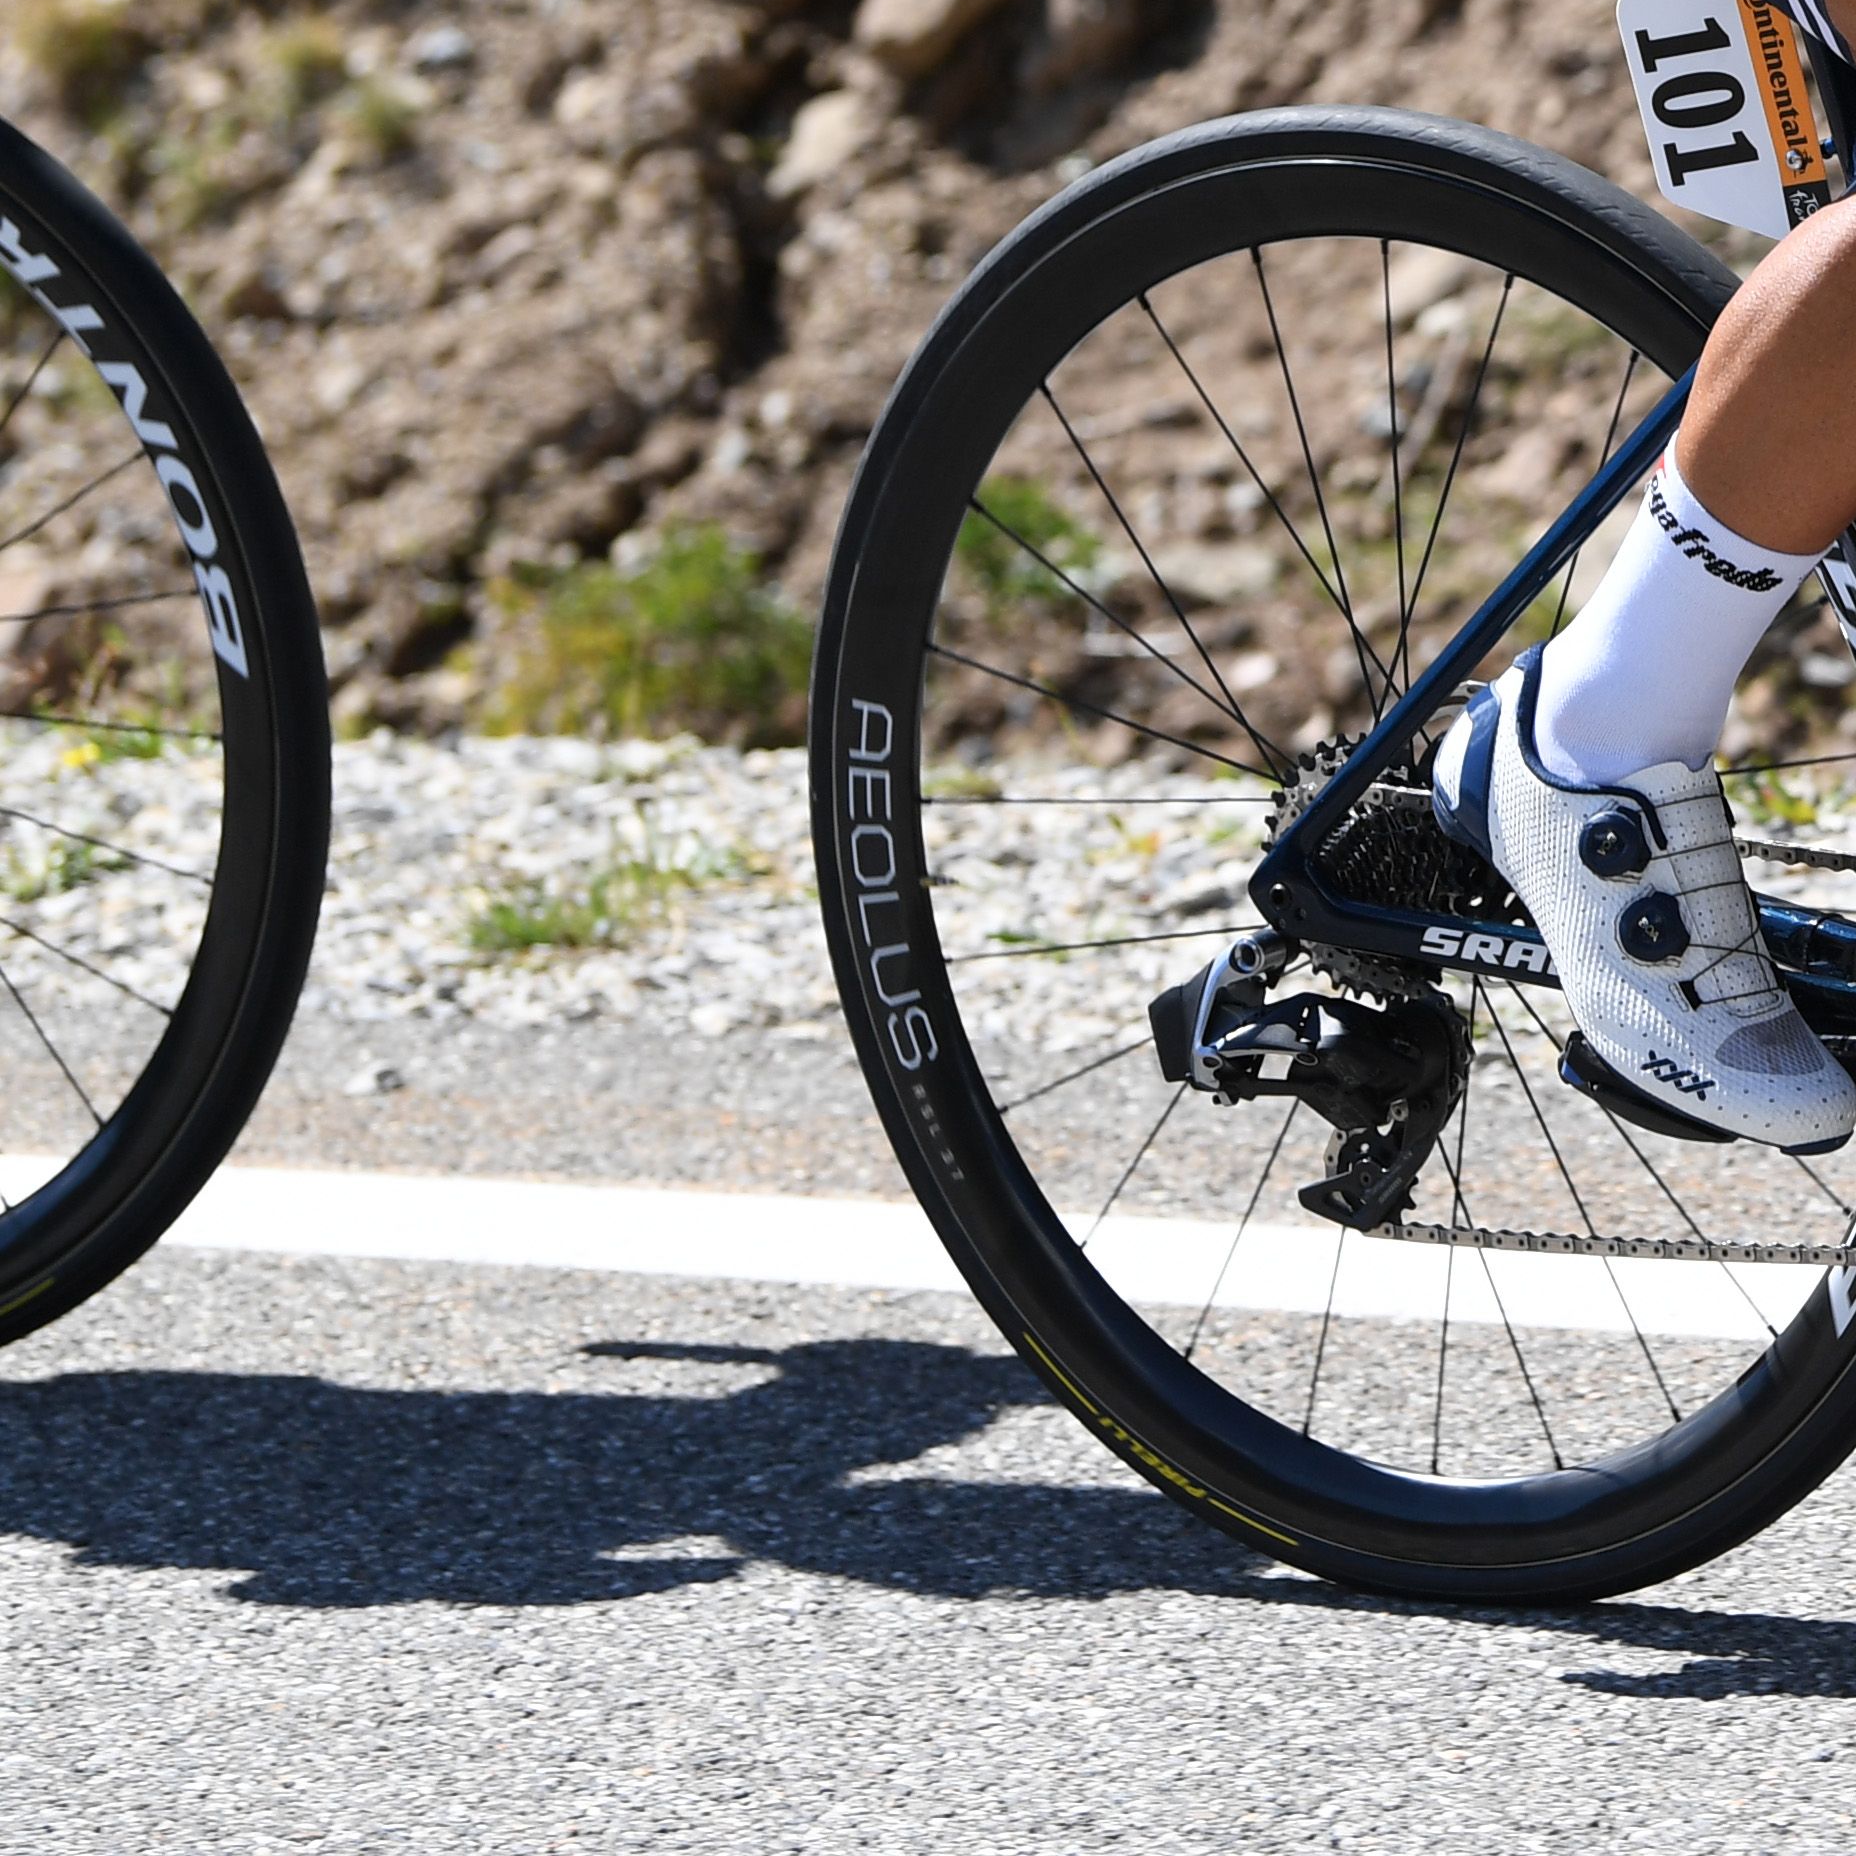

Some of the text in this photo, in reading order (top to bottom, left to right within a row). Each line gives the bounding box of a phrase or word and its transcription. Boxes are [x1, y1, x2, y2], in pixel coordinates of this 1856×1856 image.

[1634, 17, 1760, 188] 101
[847, 697, 938, 1072] AEOLUS
[1420, 926, 1556, 976] SRA
[1099, 1416, 1208, 1499] PIRELLI
